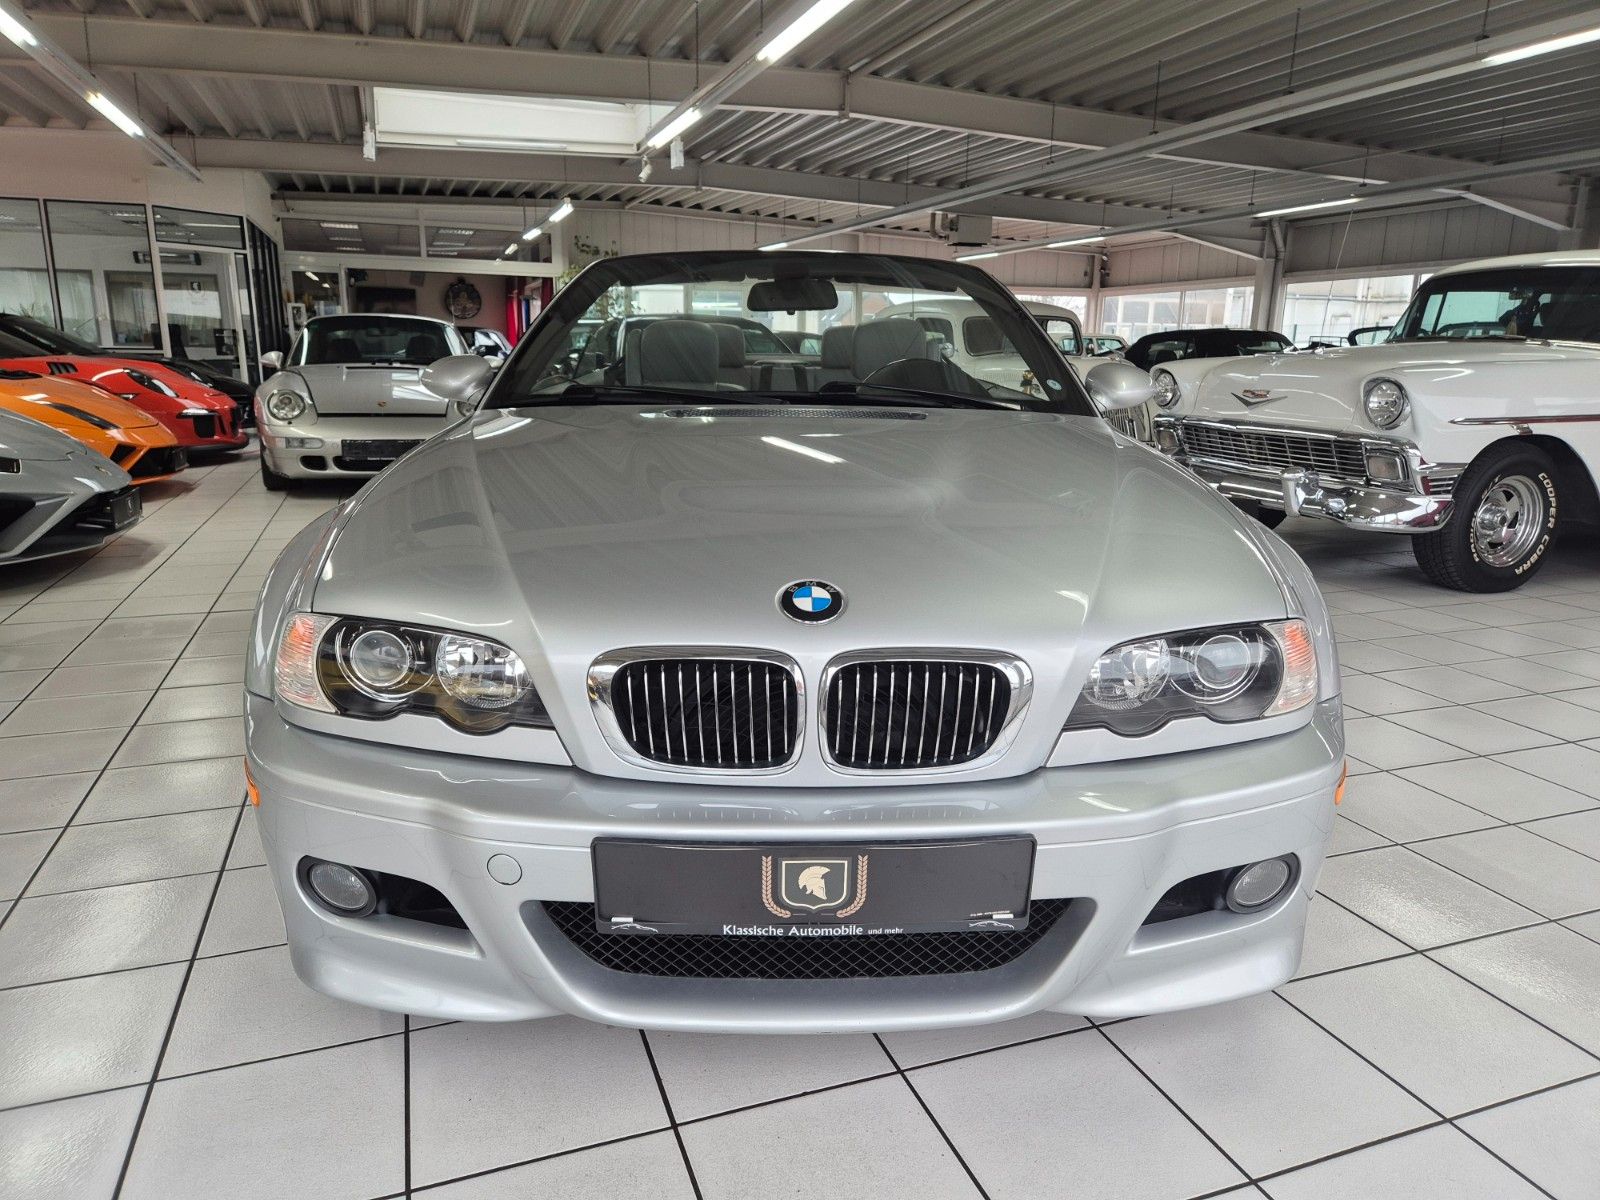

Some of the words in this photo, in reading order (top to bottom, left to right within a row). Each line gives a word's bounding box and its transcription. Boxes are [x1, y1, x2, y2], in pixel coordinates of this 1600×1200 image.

[1538, 472, 1557, 529] COOPER
[1514, 534, 1550, 575] COBRA
[788, 581, 837, 593] BMW
[722, 924, 784, 936] Klassische
[788, 925, 864, 937] Automobile
[867, 927, 883, 935] und
[884, 926, 904, 935] mehr
